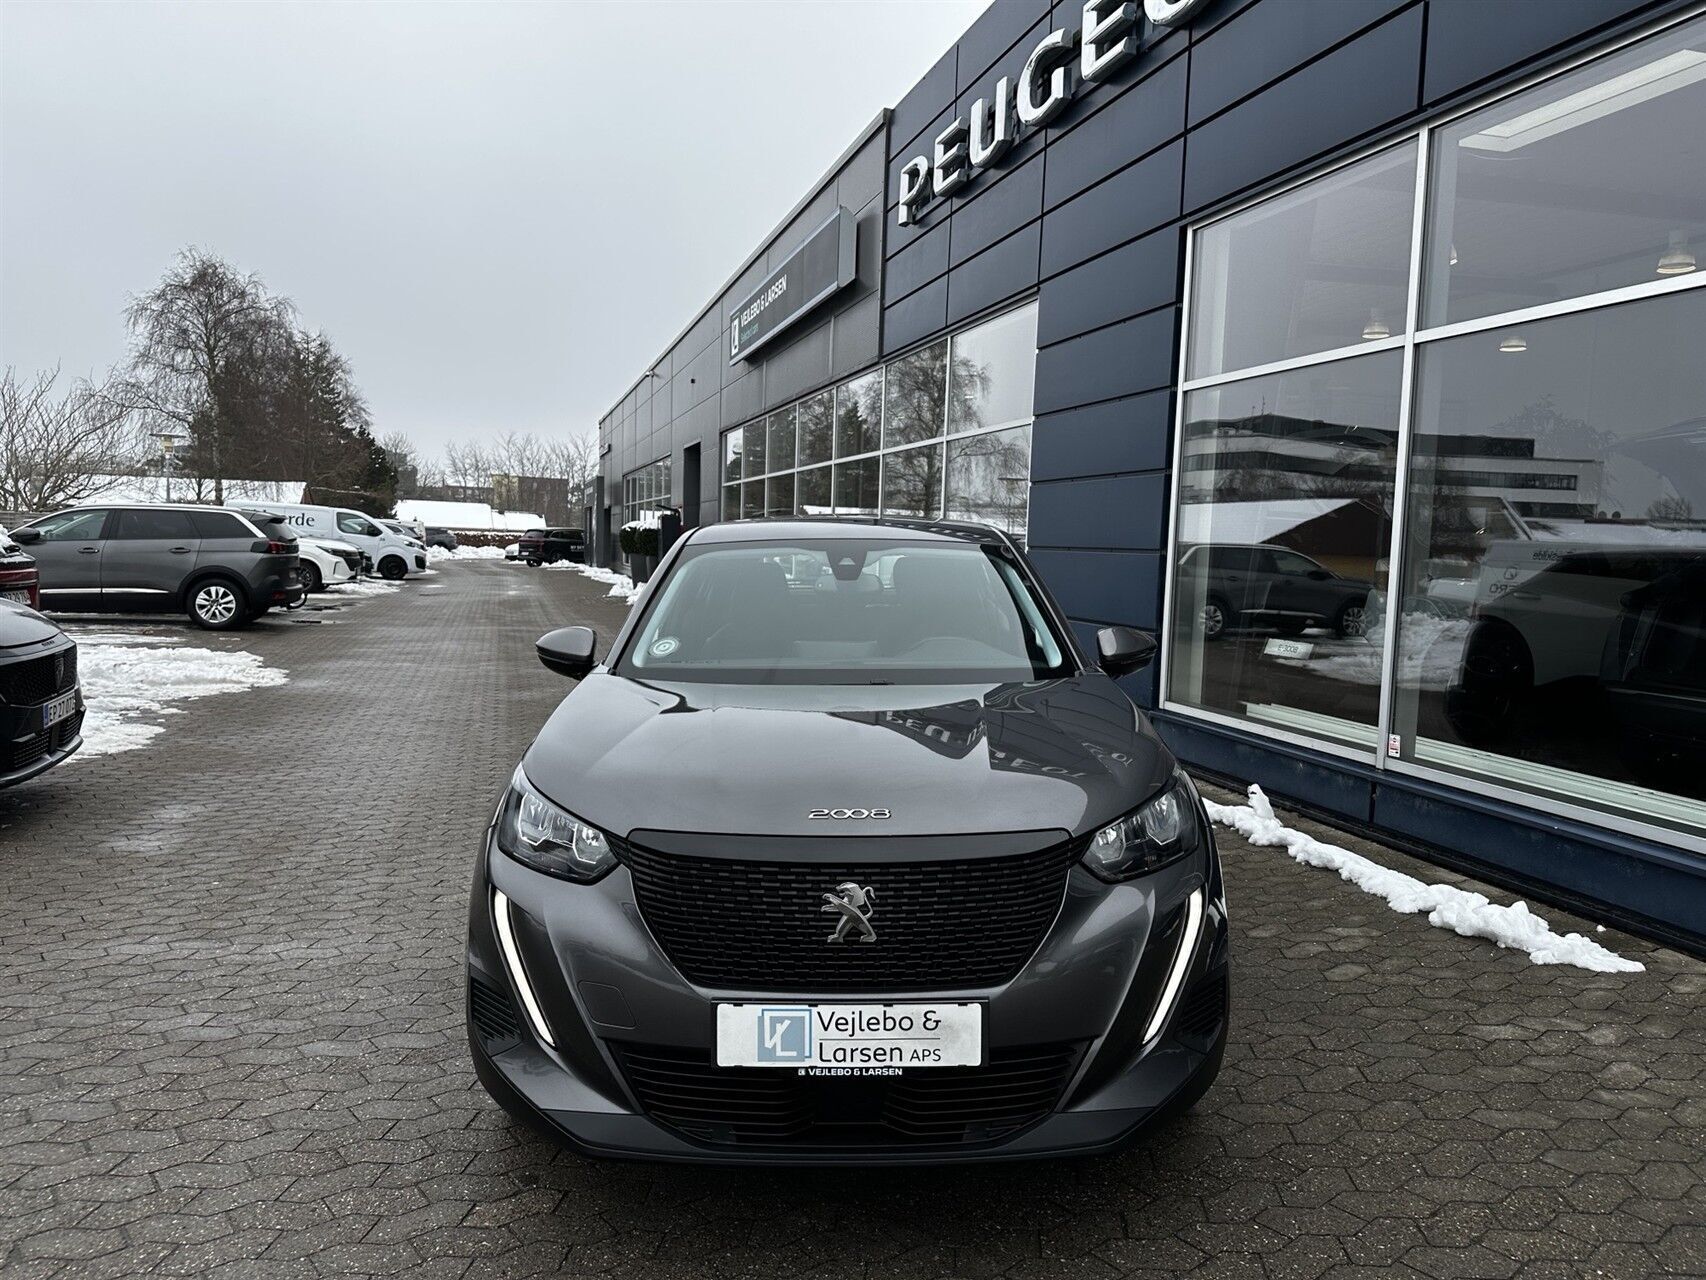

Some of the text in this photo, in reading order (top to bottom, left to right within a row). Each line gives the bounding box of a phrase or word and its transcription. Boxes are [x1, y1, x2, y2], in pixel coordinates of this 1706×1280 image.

[898, 0, 1204, 226] PEUGE
[764, 273, 787, 307] LARSEN
[288, 512, 315, 528] rde
[808, 808, 890, 820] 2008
[817, 1010, 941, 1037] Vejlebo &
[818, 1042, 941, 1063] Larsen APS
[808, 1068, 851, 1076] VEJLEBO
[853, 1068, 860, 1076] &
[862, 1068, 903, 1076] LARSEN
